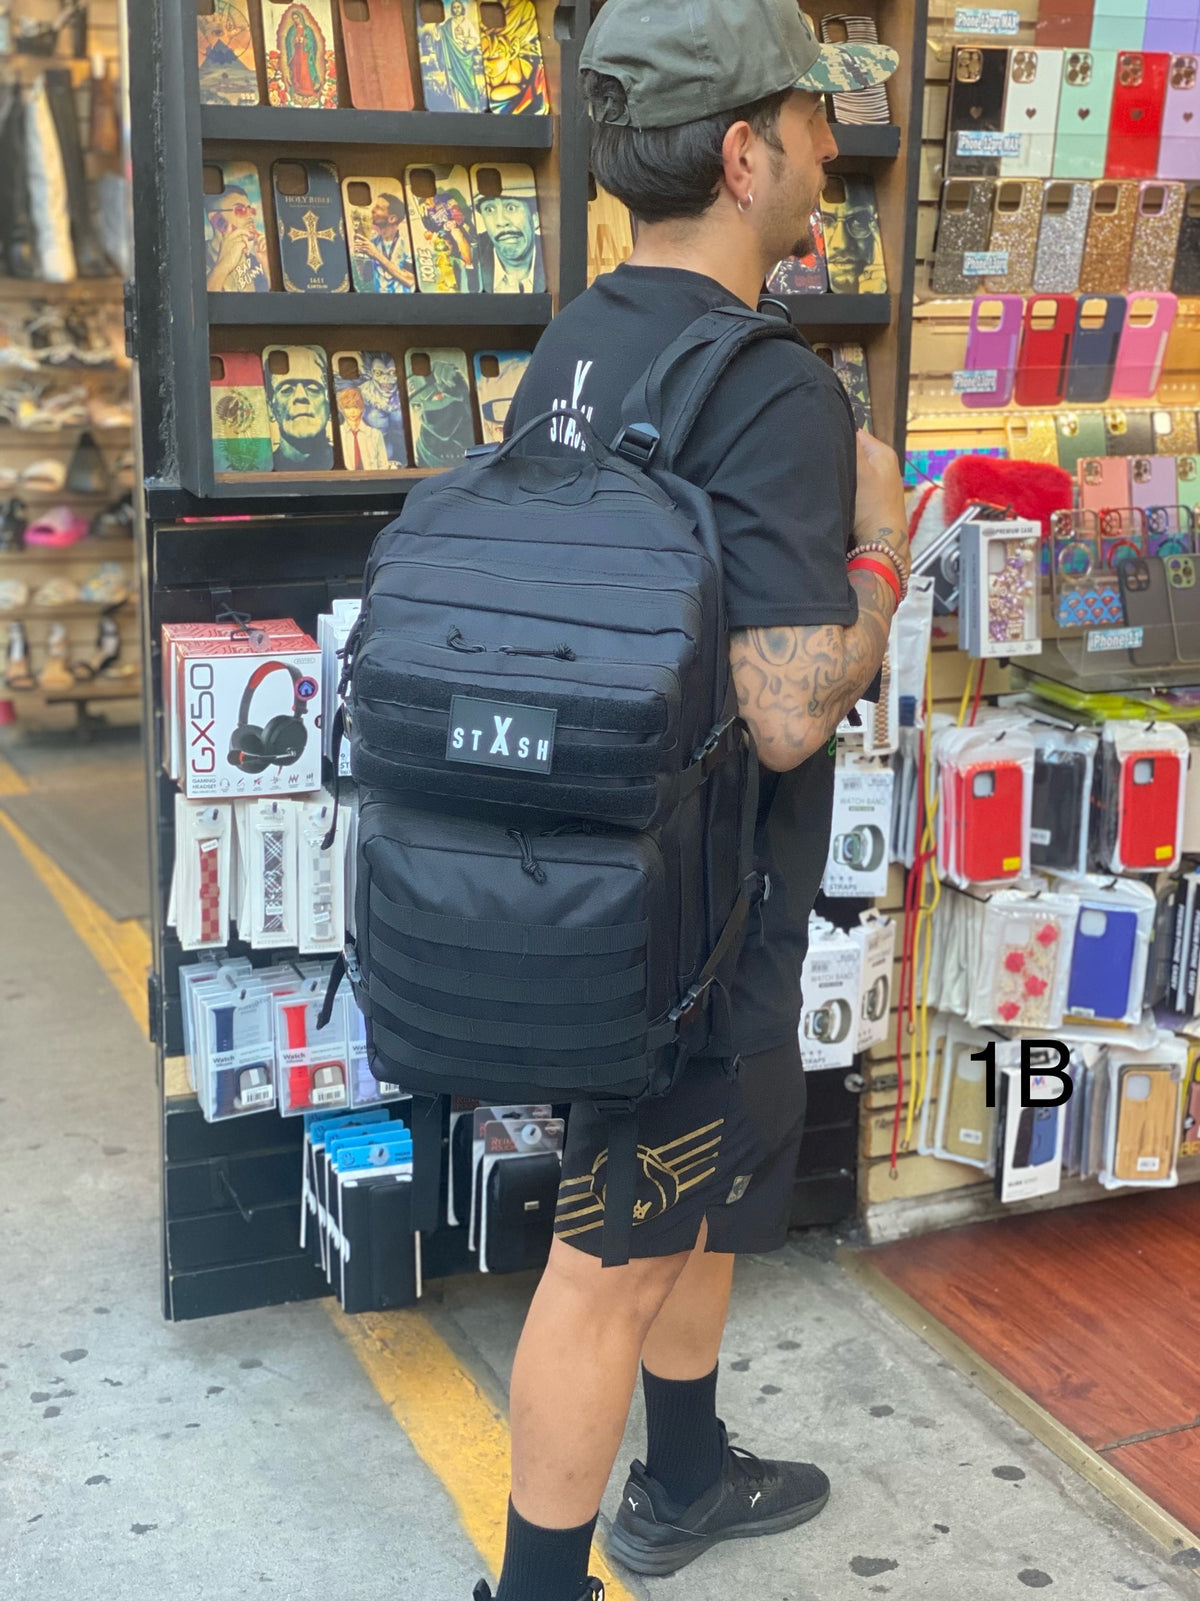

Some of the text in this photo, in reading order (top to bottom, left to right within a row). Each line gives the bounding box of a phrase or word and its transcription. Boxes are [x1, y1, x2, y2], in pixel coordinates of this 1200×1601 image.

[955, 12, 979, 28] iPhone
[958, 135, 982, 151] iPhone
[285, 195, 308, 204] HOLY
[417, 248, 436, 283] KOBE
[1091, 631, 1140, 649] iPhone 11
[190, 663, 215, 773] GX50
[867, 797, 886, 805] BAND
[811, 972, 853, 982] WATCH BAND
[213, 1055, 235, 1065] Watch
[283, 1052, 306, 1061] Watch
